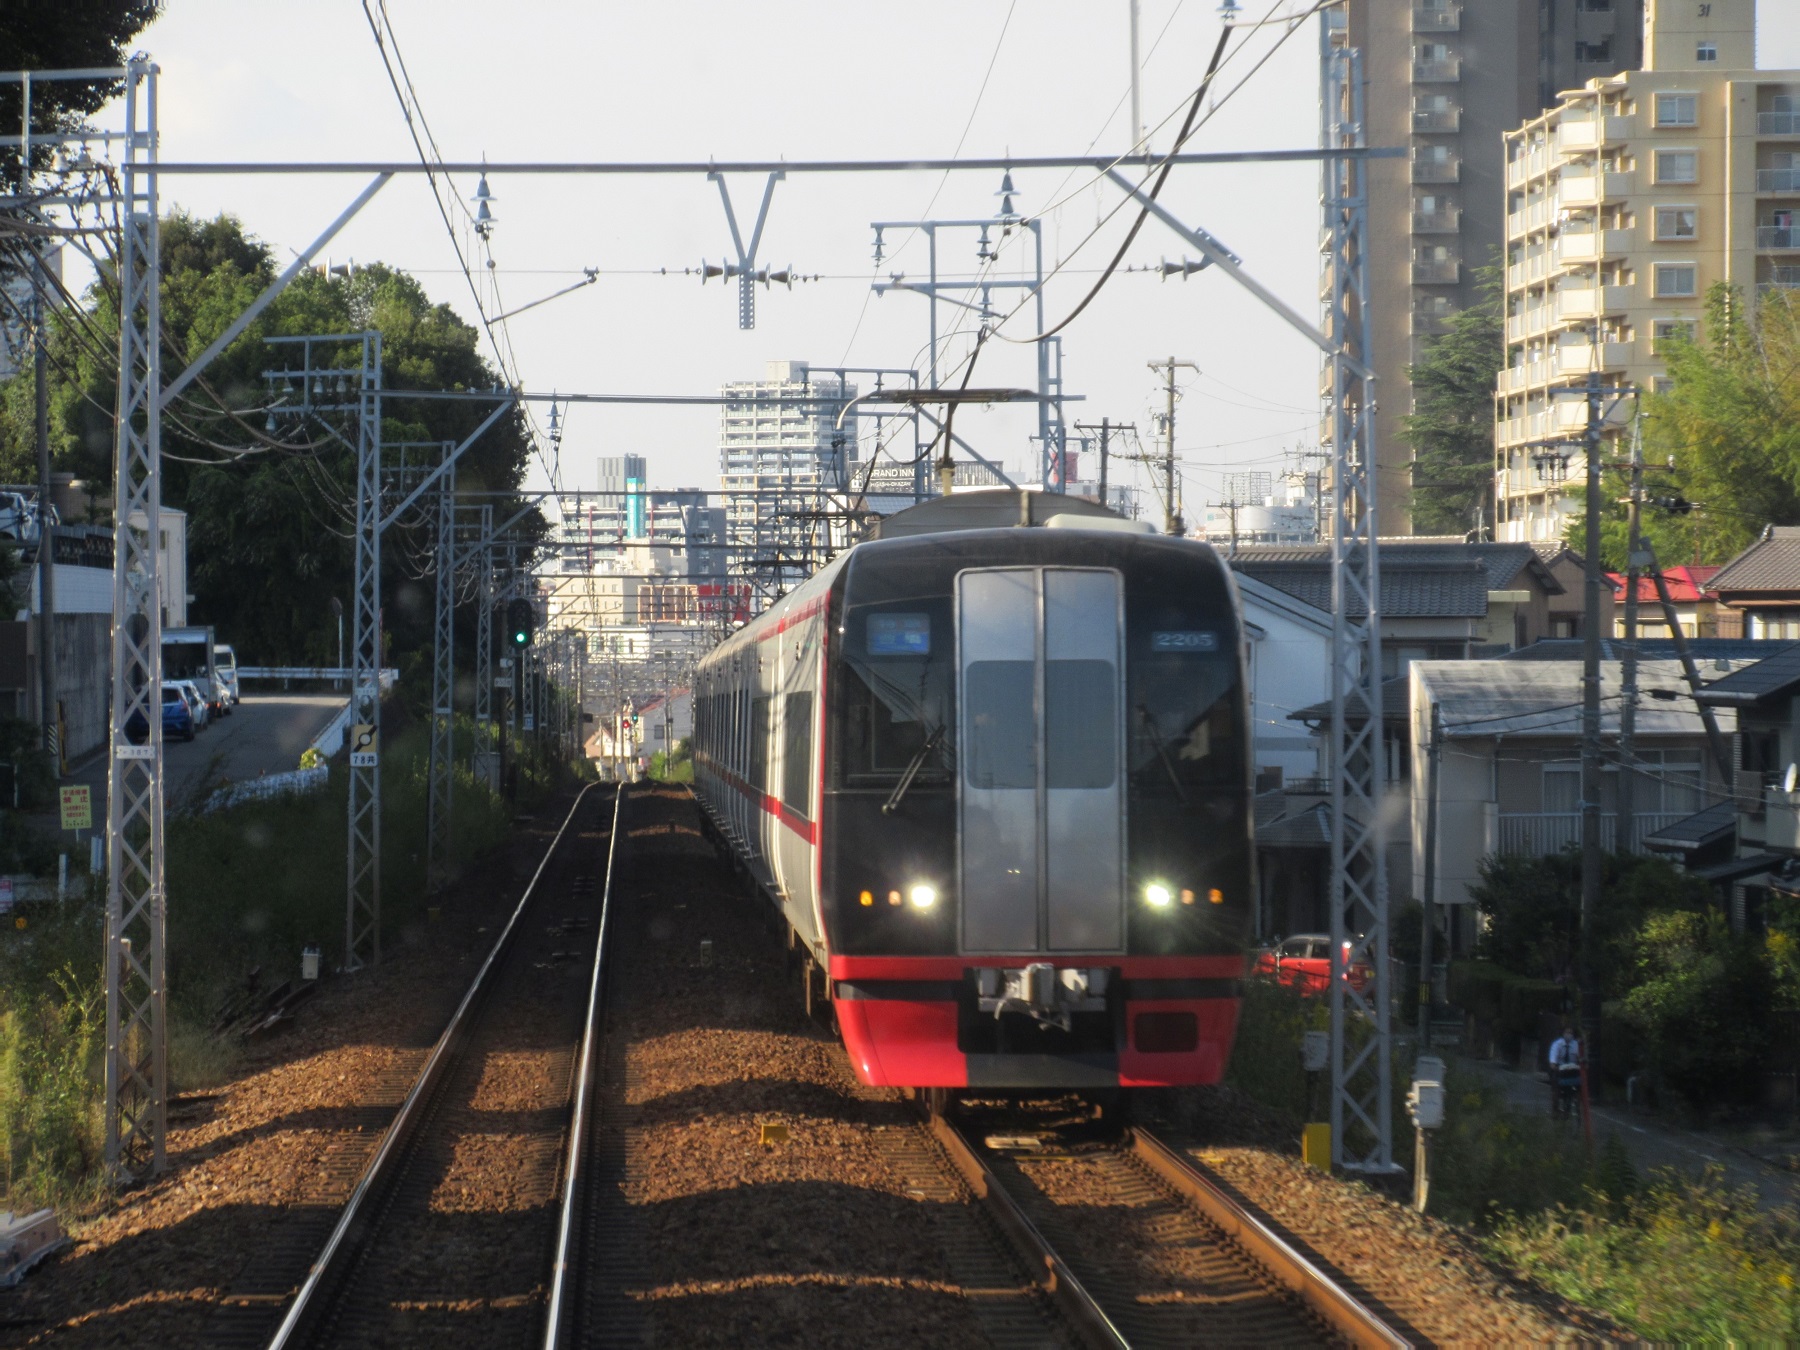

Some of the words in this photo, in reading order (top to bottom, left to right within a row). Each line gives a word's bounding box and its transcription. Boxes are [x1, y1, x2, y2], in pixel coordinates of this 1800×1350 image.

[1698, 4, 1711, 17] 31
[899, 468, 915, 477] INN
[1157, 633, 1213, 647] 2205
